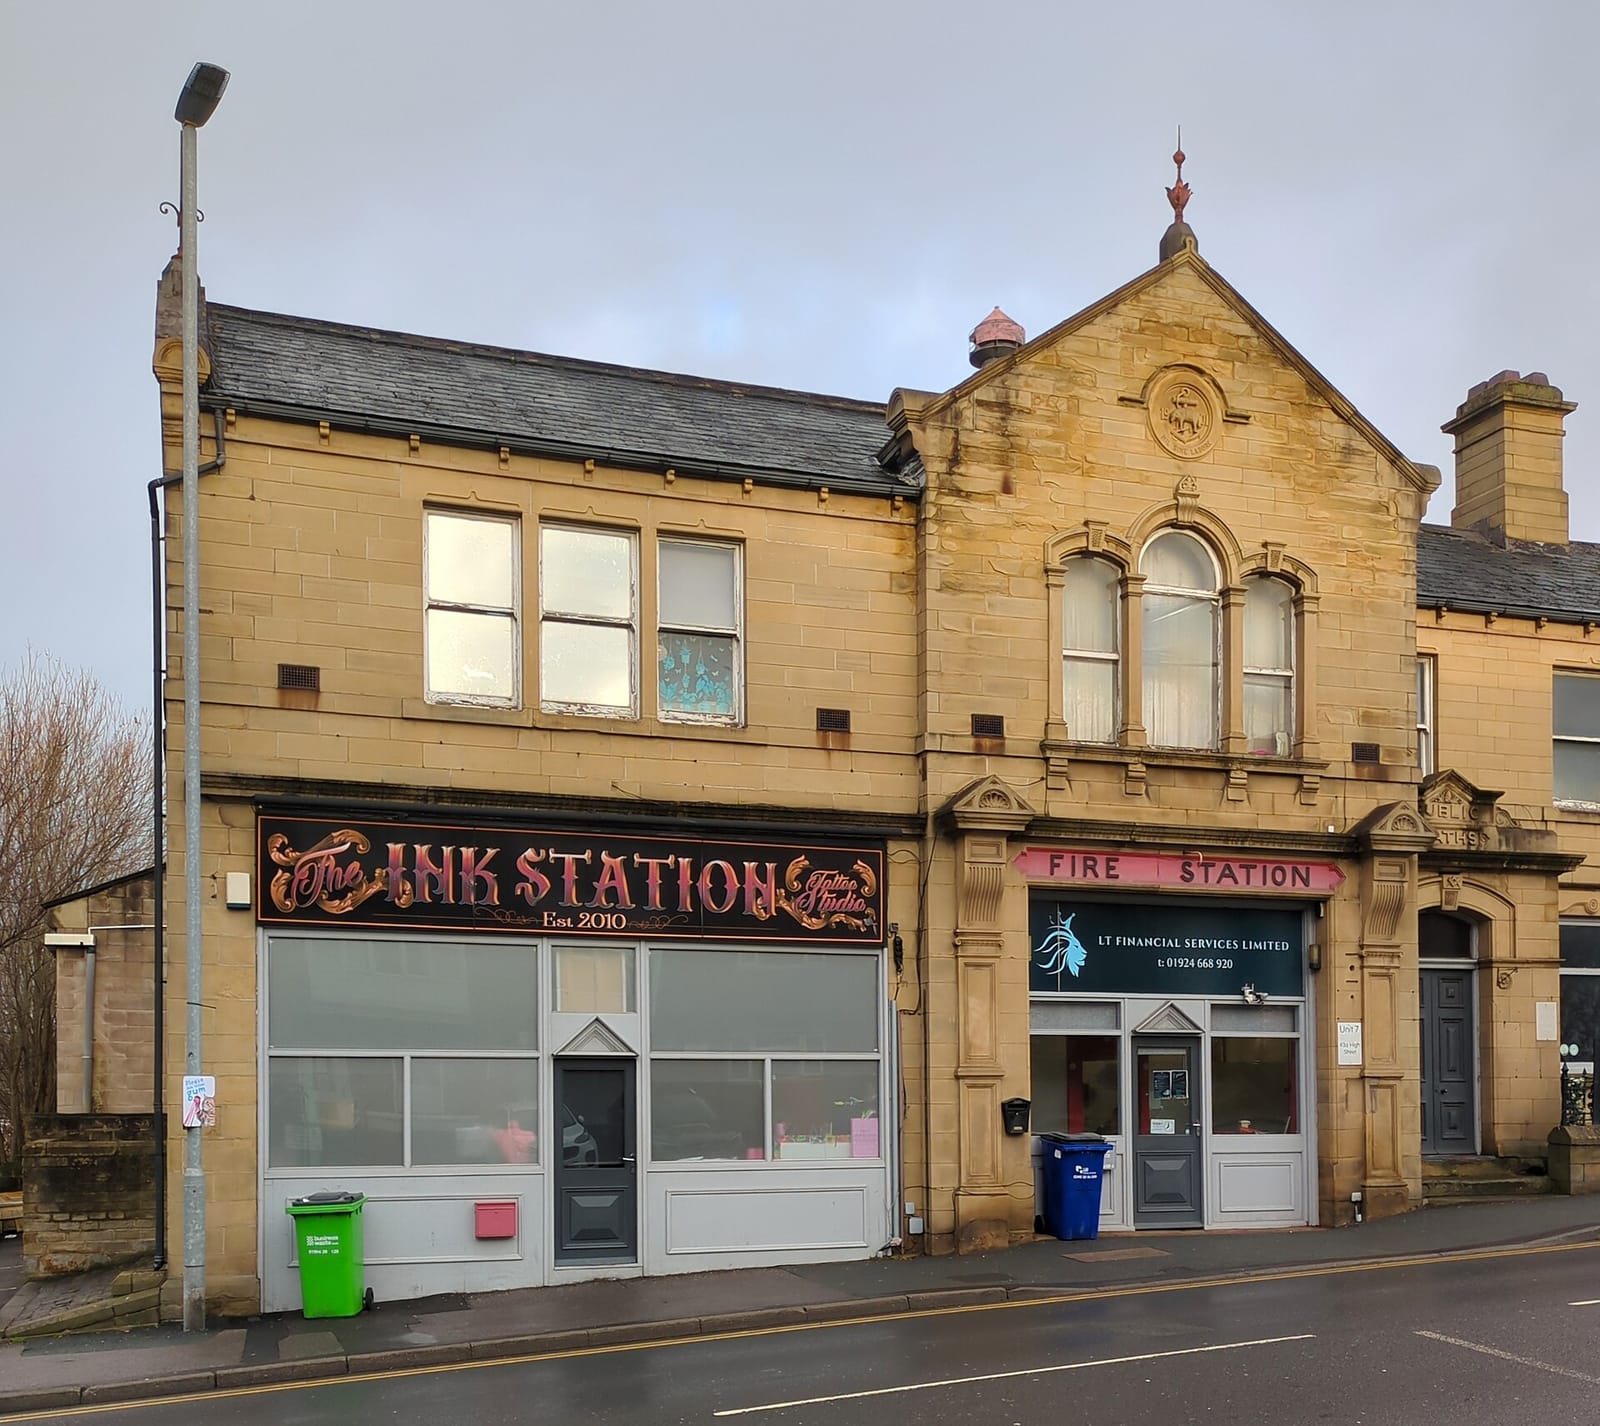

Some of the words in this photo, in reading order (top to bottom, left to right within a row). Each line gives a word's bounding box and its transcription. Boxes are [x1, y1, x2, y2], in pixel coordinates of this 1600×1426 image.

[1425, 803, 1480, 820] UBLIC
[291, 842, 363, 908] The
[384, 842, 501, 905] INK
[514, 847, 777, 916] STATION
[1049, 854, 1120, 879] FIRE
[1179, 860, 1311, 888] STATION
[805, 870, 858, 897] Tattoo
[794, 888, 866, 915] Studio
[542, 911, 574, 928] Est.
[577, 912, 627, 930] 2010
[1098, 936, 1112, 946] LT
[1116, 936, 1181, 948] FINANCIAL
[1184, 938, 1239, 949] SERVICES
[1242, 940, 1290, 951] LIMITED
[1158, 958, 1165, 967] t:
[1166, 957, 1195, 968] 01924
[1197, 958, 1214, 968] 668
[1216, 959, 1233, 969] 920
[187, 1087, 206, 1101] gum
